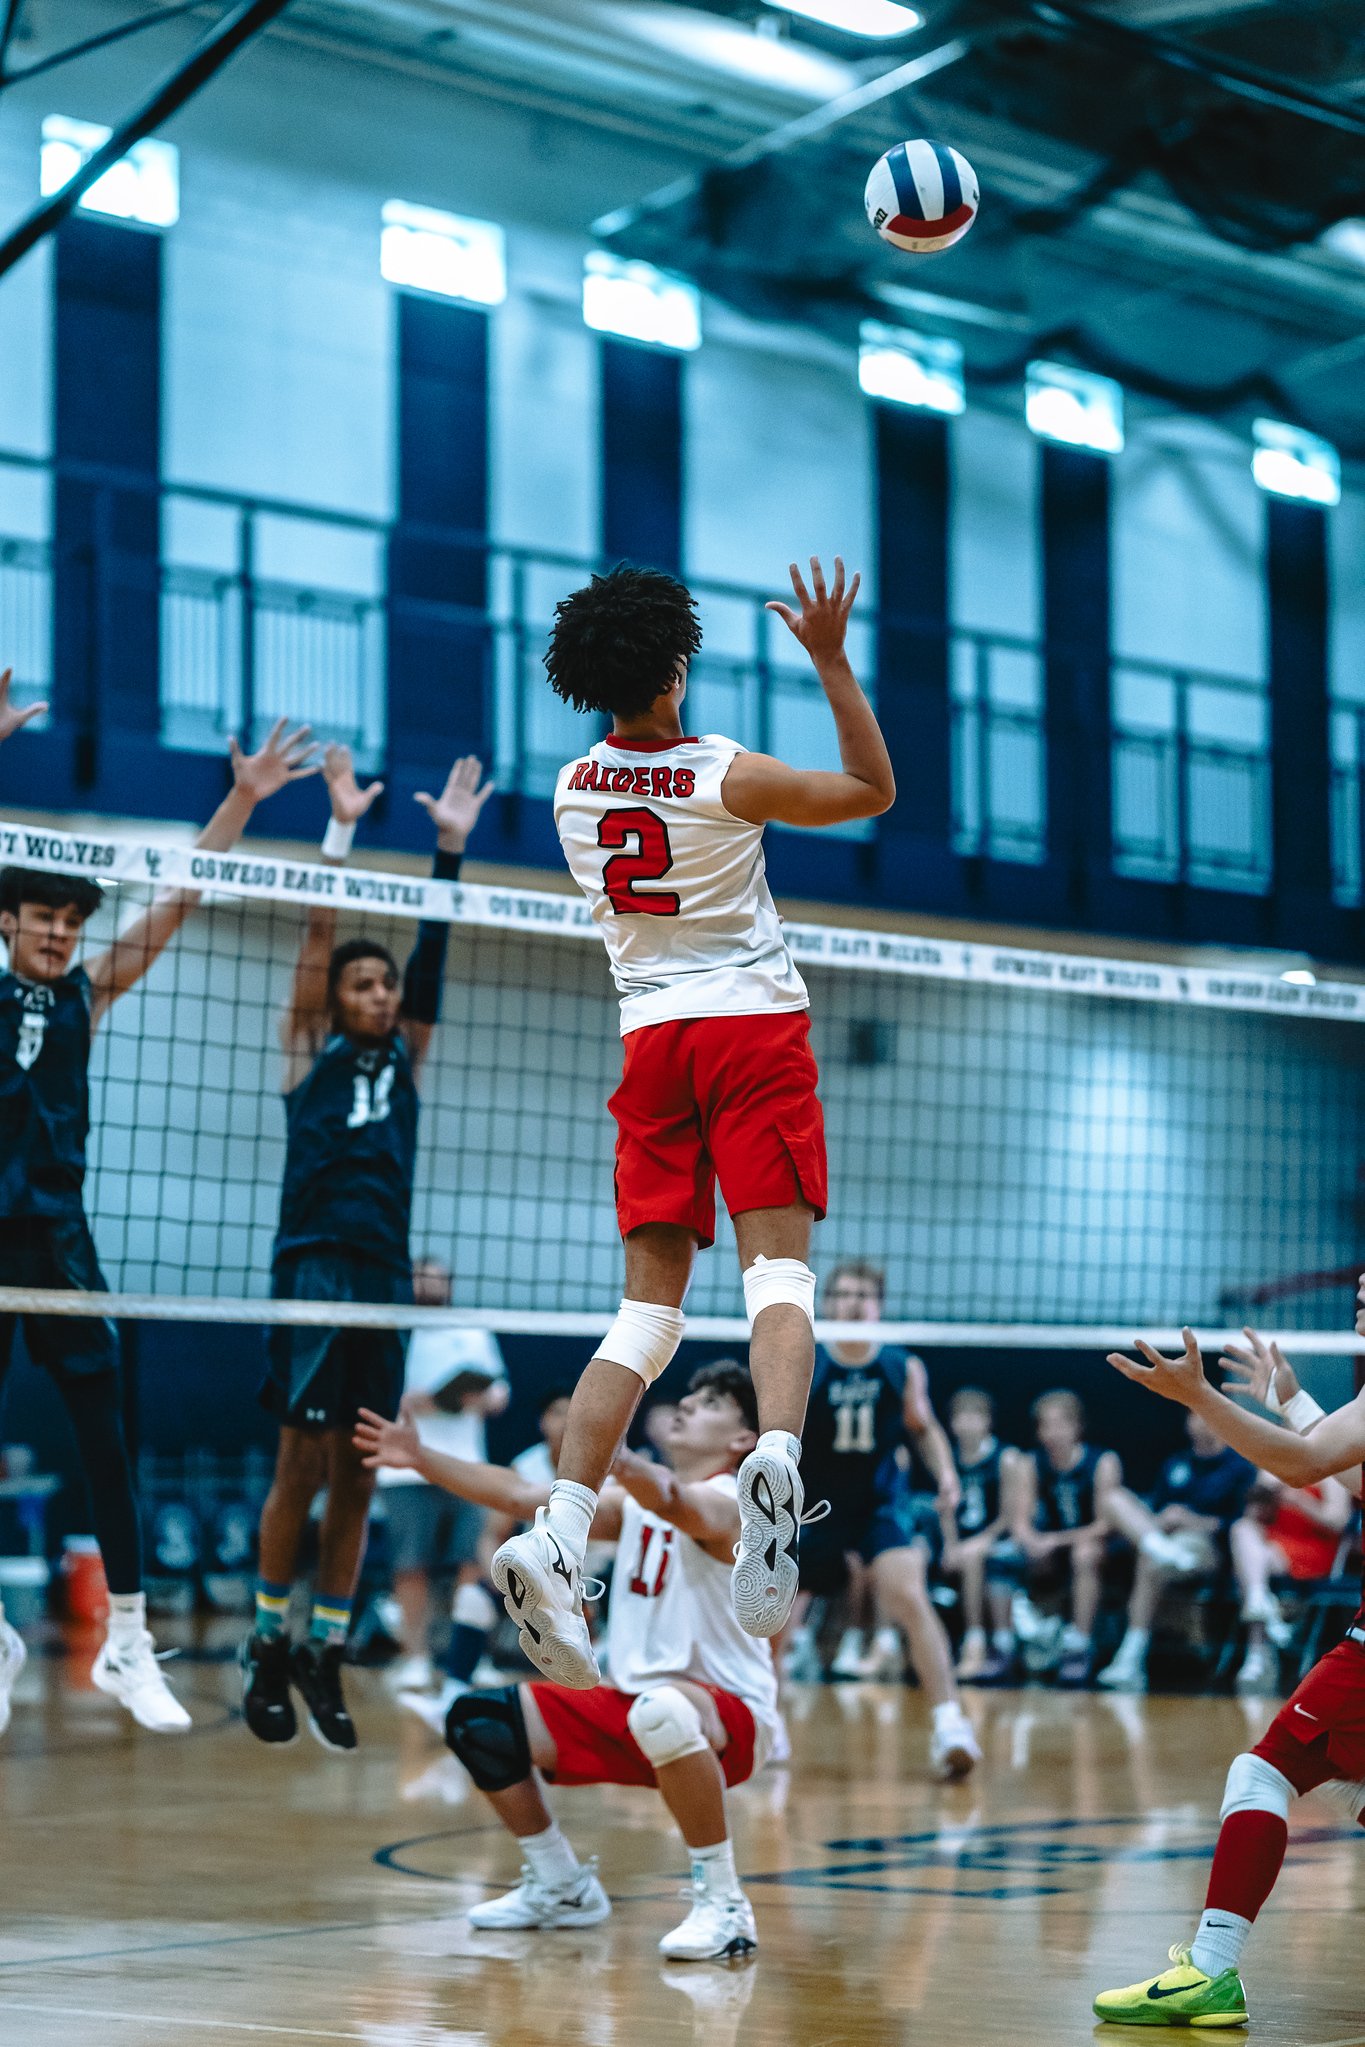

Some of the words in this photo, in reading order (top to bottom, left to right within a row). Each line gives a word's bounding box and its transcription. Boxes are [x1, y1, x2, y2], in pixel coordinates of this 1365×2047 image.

[568, 761, 696, 798] RAIDERS
[282, 866, 337, 896] EAST
[597, 806, 681, 916] 2
[832, 1402, 875, 1454] 11
